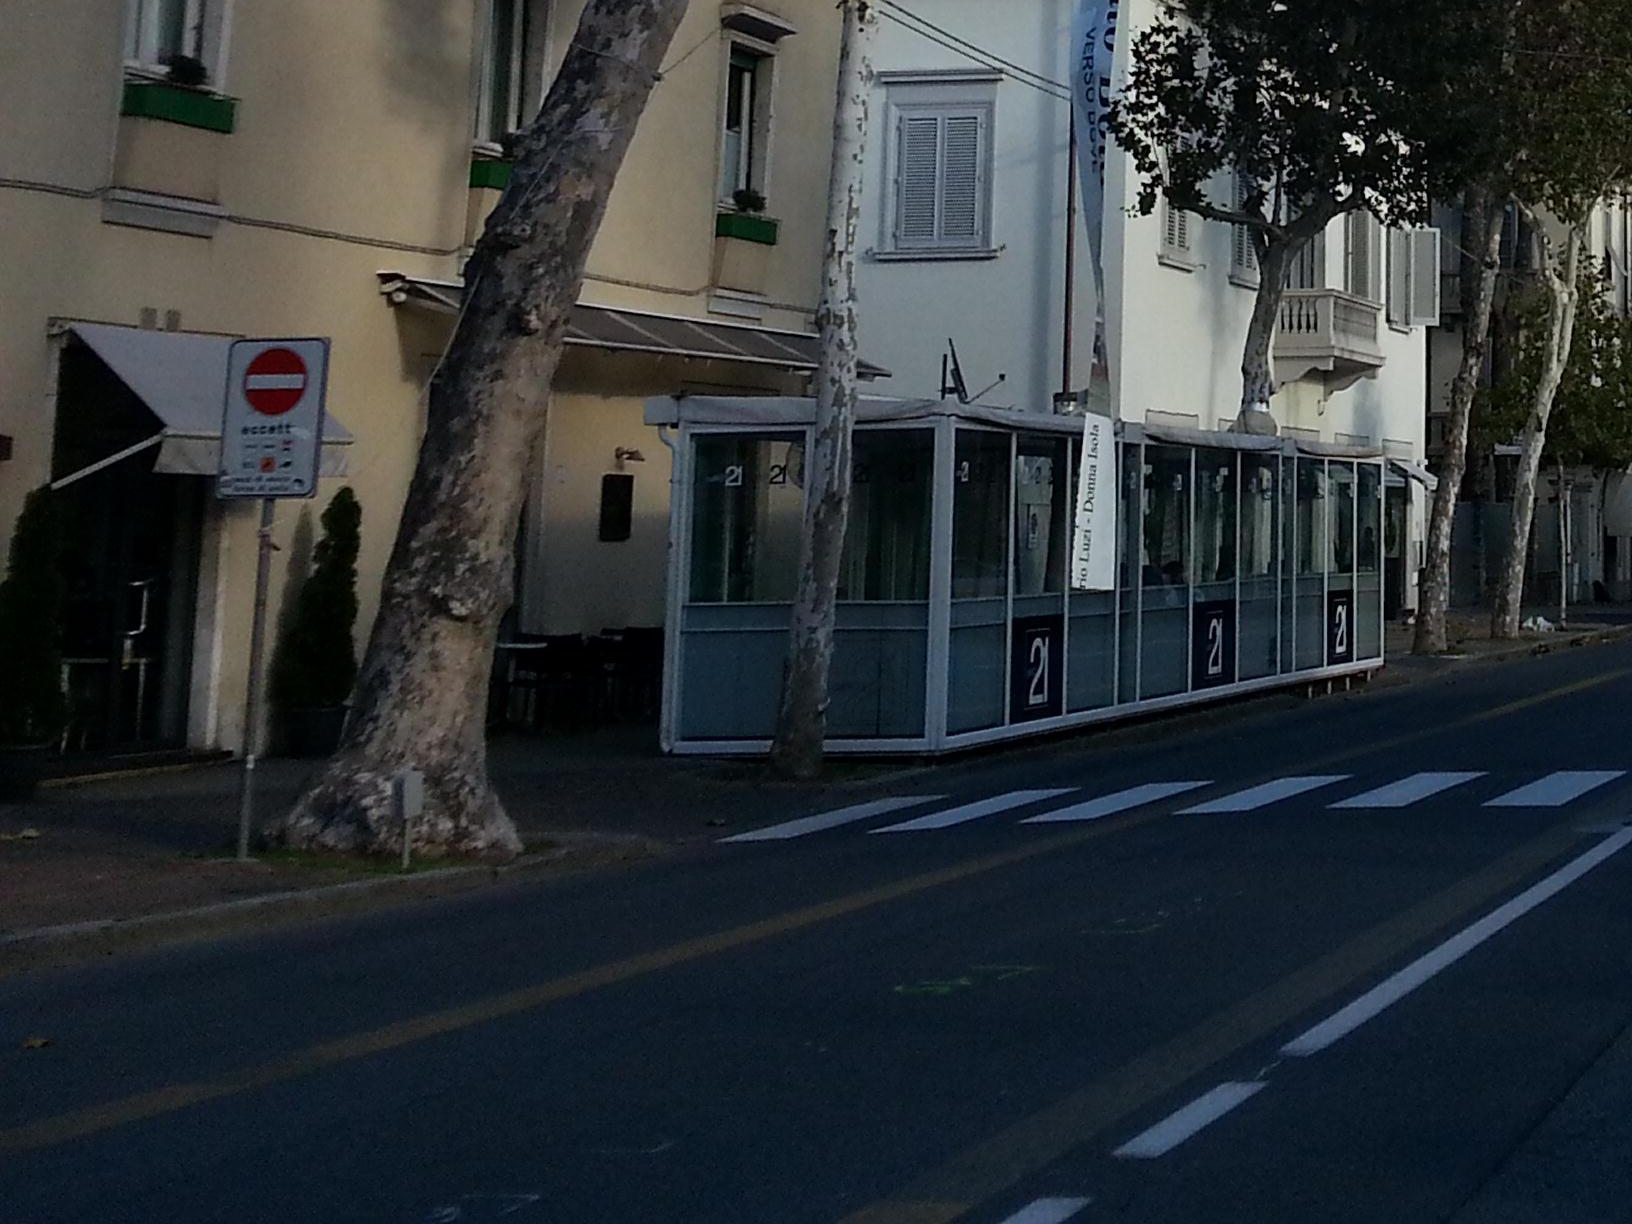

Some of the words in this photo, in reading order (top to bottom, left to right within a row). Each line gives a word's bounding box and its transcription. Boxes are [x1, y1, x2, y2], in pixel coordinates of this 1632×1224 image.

[1083, 26, 1098, 104] VERSO
[243, 424, 301, 435] eccett
[1087, 424, 1099, 459] Isola
[1083, 464, 1097, 513] Donna
[1028, 637, 1050, 706] 21
